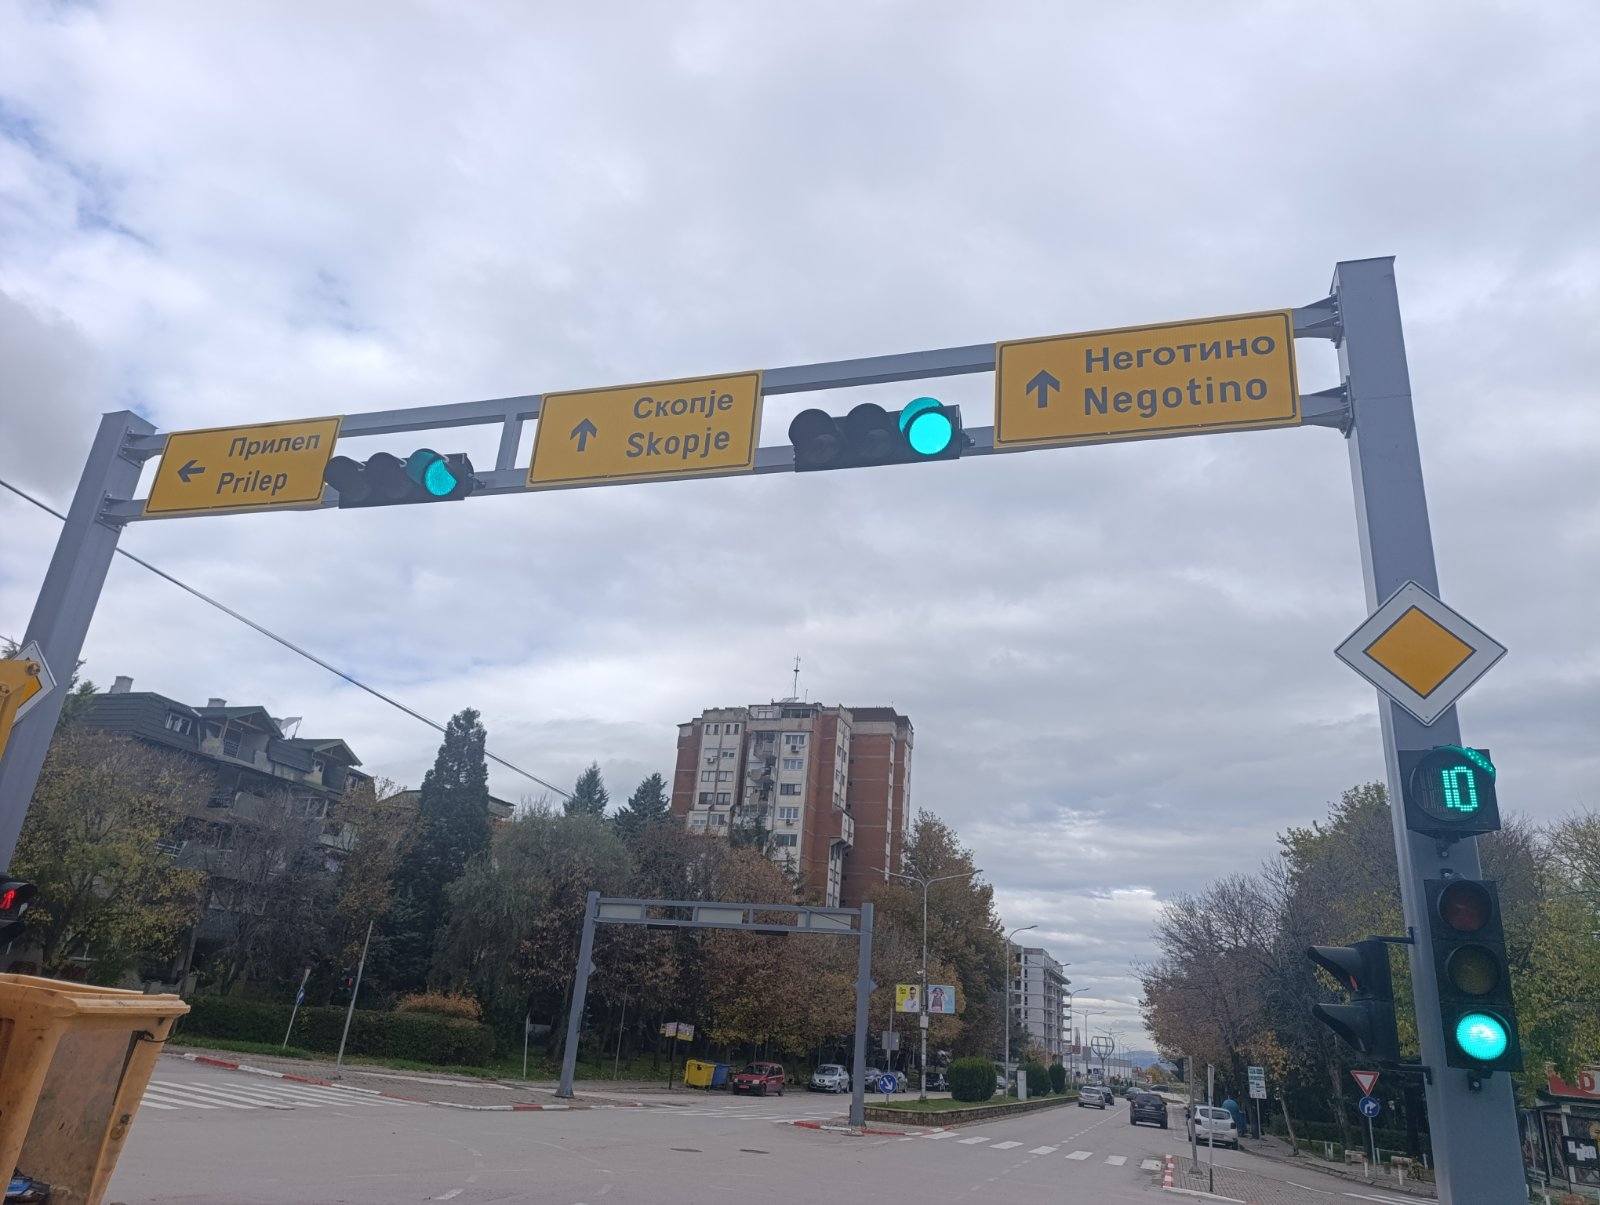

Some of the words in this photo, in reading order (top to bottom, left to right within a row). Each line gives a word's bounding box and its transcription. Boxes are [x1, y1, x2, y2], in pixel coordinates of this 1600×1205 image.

[1085, 336, 1275, 373] Неготино
[633, 390, 734, 419] Скопје
[1085, 377, 1268, 418] Negotino
[228, 433, 320, 460] Прилеп
[626, 427, 730, 459] Skopje
[216, 470, 288, 494] Prilep
[1442, 766, 1478, 811] 10
